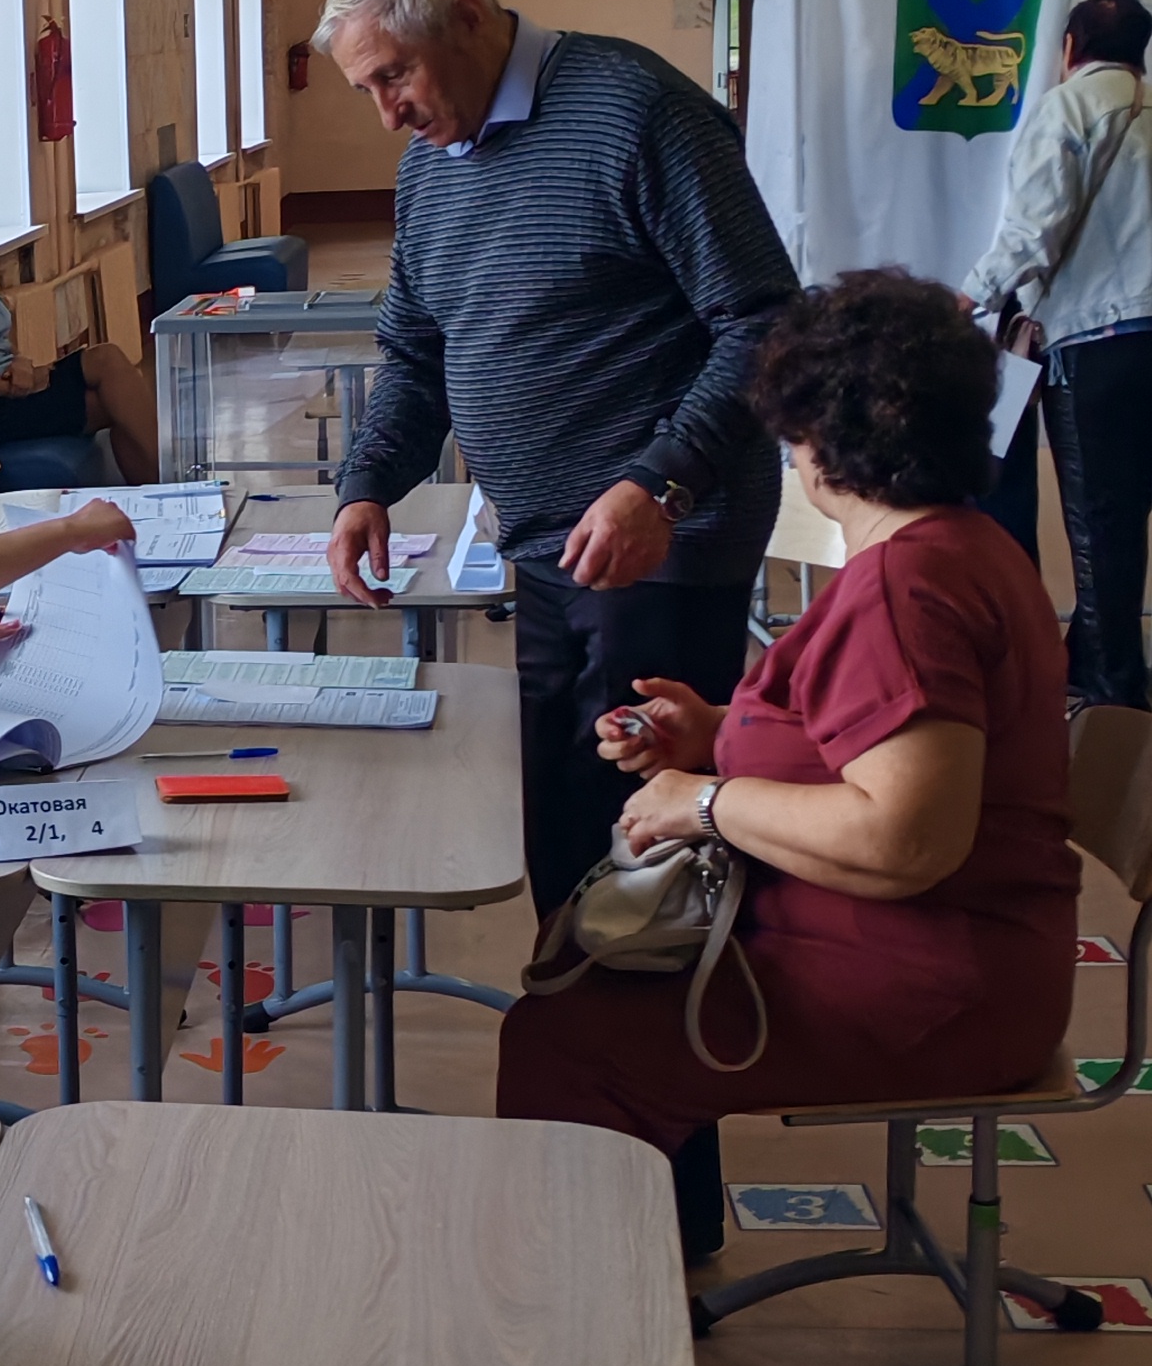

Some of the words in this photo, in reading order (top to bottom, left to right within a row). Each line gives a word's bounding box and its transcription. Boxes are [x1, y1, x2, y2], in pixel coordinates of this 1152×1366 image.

[25, 822, 66, 844] 2/1,
[91, 820, 104, 835] 4
[783, 1195, 826, 1220] 3
